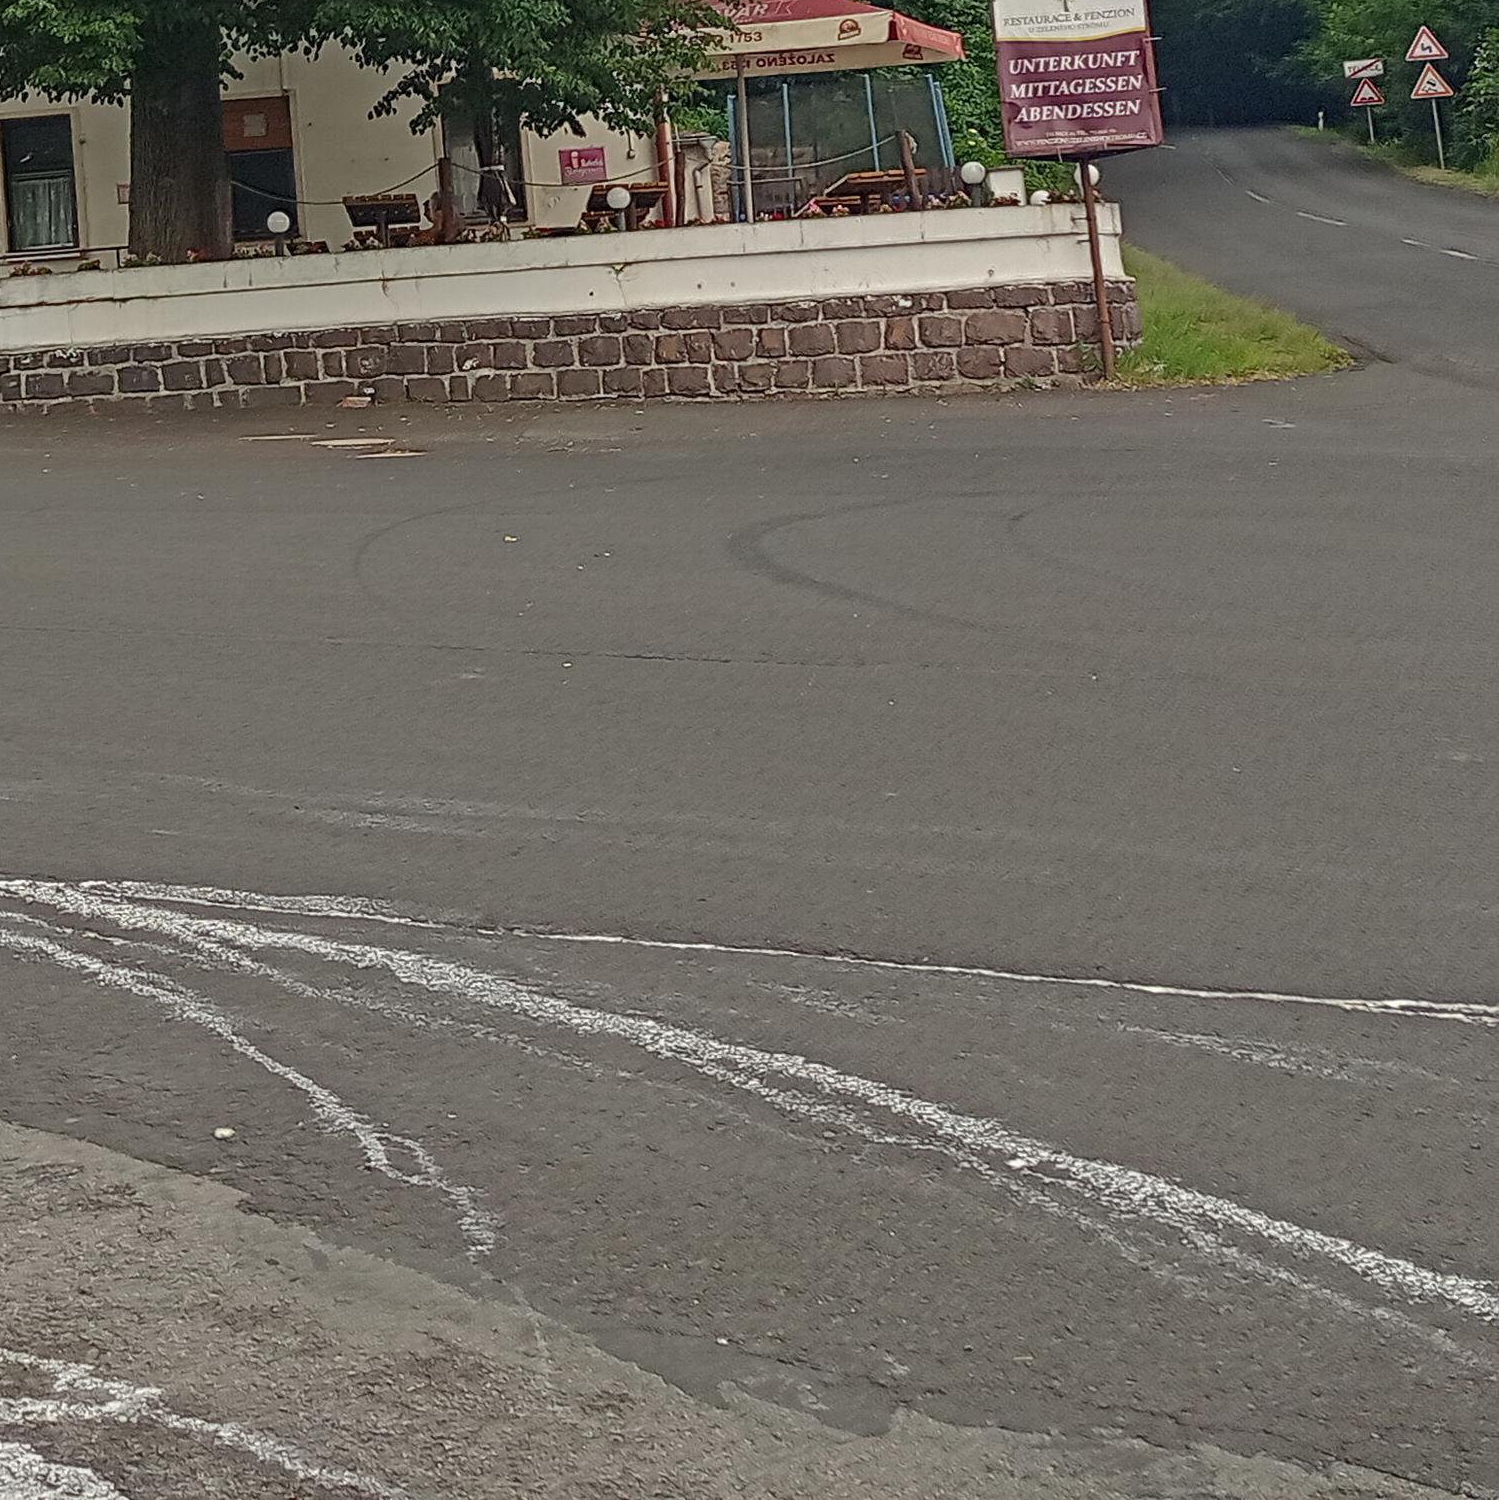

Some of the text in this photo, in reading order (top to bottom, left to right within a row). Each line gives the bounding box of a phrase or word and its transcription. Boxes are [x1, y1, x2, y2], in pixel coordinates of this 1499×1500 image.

[1003, 7, 1136, 27] RESTAURACE & PENZION
[729, 31, 763, 44] 1753
[1009, 51, 1140, 74] UNTERKUNFT
[1010, 75, 1143, 98] MITTAGESSEN
[1015, 99, 1141, 122] ABENDESSEN
